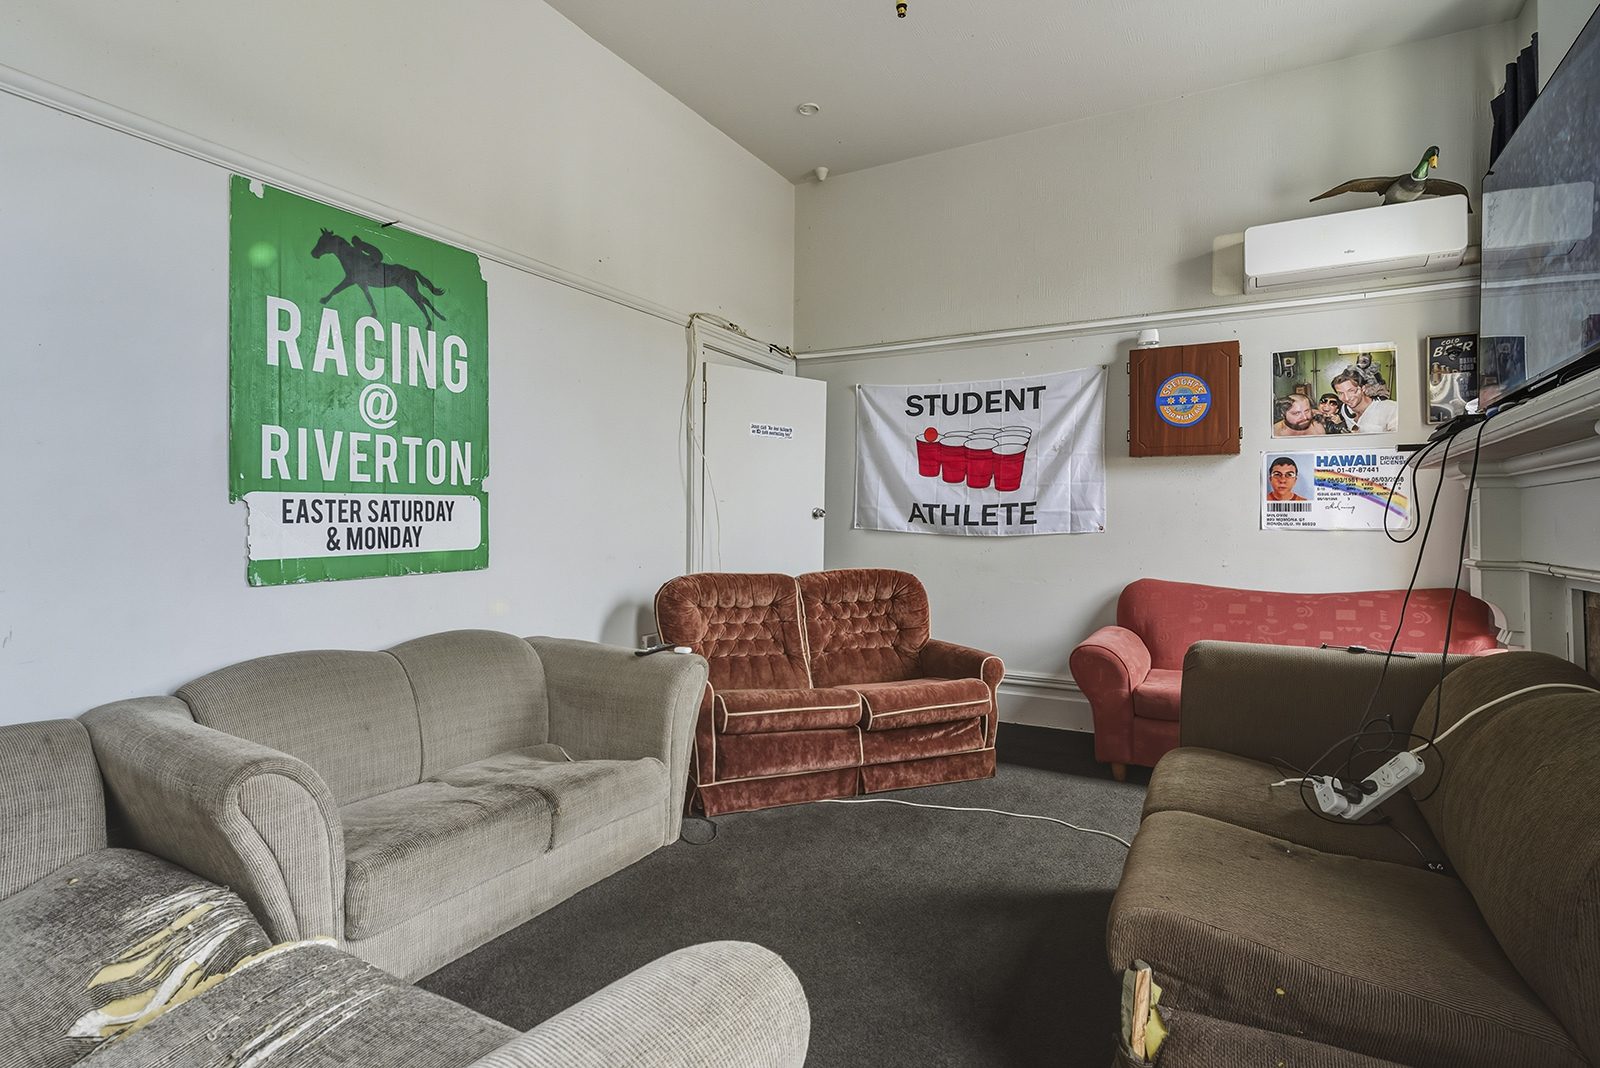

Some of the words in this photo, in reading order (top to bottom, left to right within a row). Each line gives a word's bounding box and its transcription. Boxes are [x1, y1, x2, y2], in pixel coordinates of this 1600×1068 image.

[266, 295, 468, 393] RACING
[1433, 341, 1474, 357] BER
[1441, 338, 1460, 346] COLD
[358, 383, 398, 429] @
[905, 386, 1046, 416] STUDENT
[261, 424, 472, 486] RIVERTON
[1316, 454, 1377, 467] HAWAII
[281, 498, 362, 524] EASTER
[367, 500, 455, 523] SATURDAY
[908, 501, 1038, 526] ATHLETE
[326, 526, 341, 551] &
[346, 525, 423, 550] MONDAY
